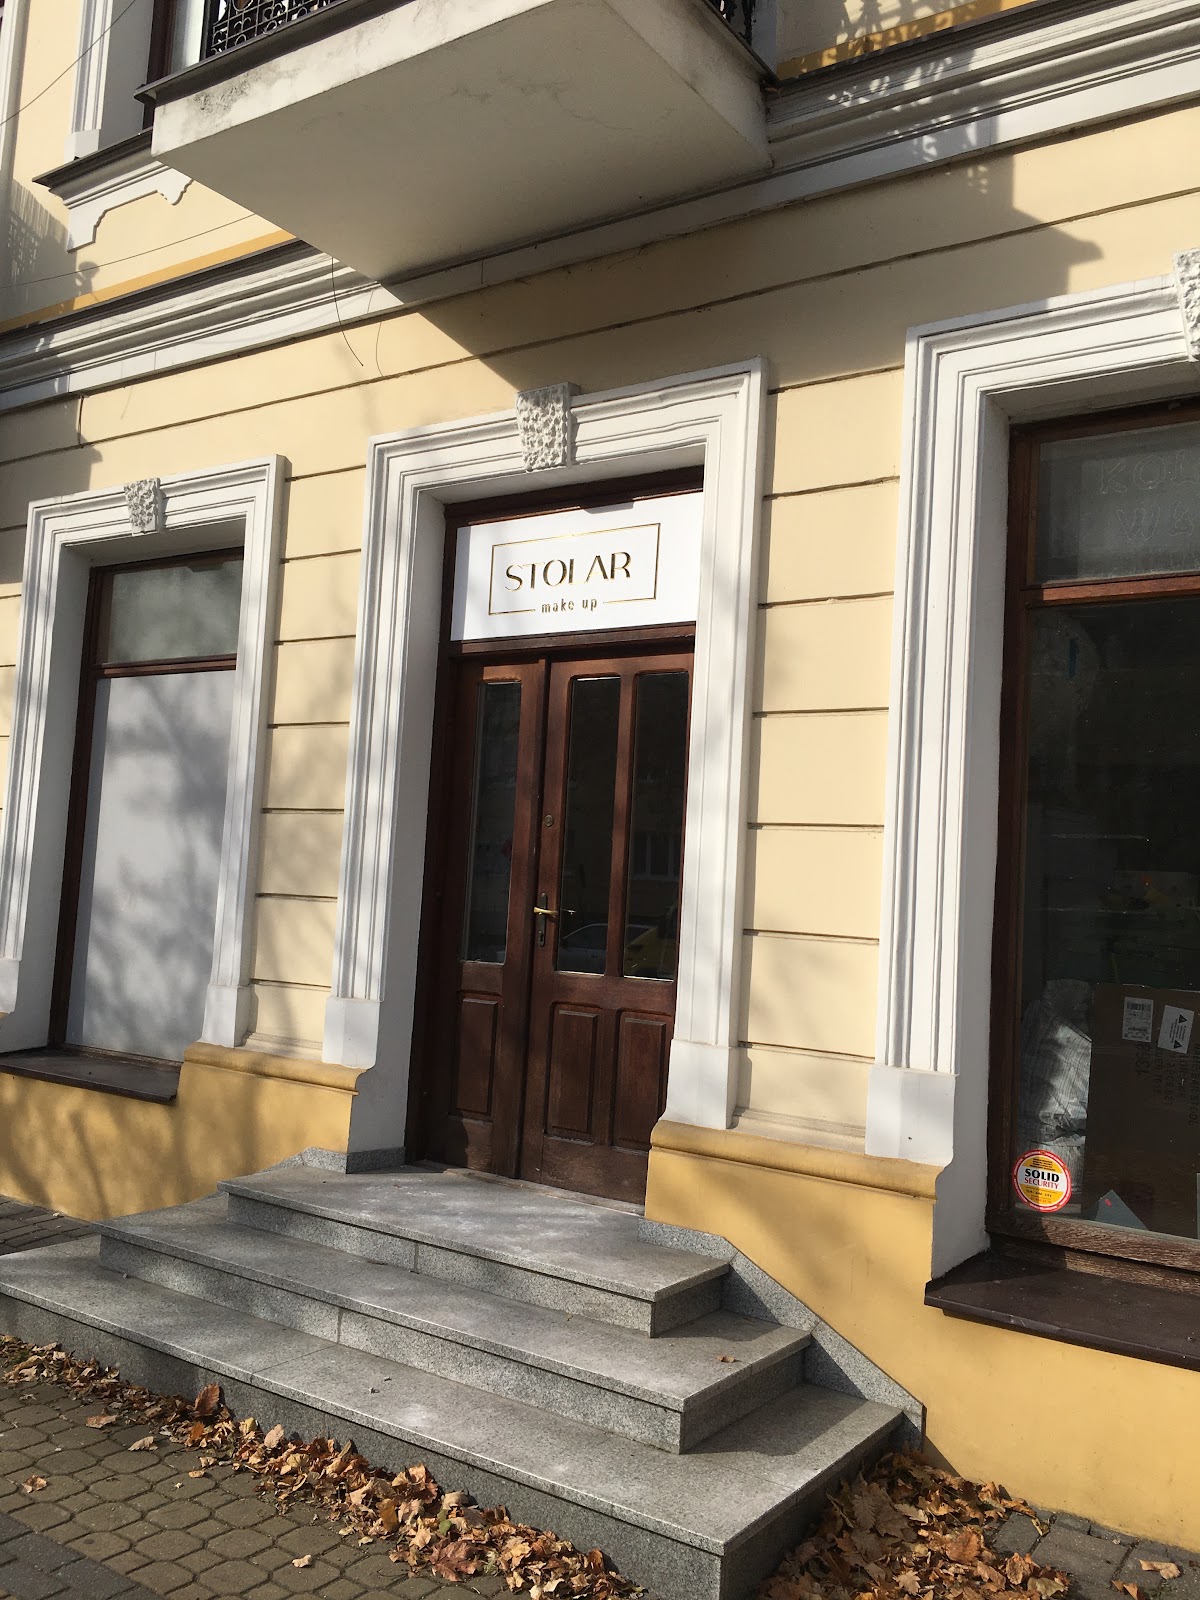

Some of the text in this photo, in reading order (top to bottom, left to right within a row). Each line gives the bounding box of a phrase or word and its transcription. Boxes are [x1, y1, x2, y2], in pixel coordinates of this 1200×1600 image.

[504, 550, 632, 592] STOLAR
[541, 598, 598, 614] make up
[1024, 1168, 1060, 1183] SOLID
[1024, 1177, 1060, 1190] SECURITY
